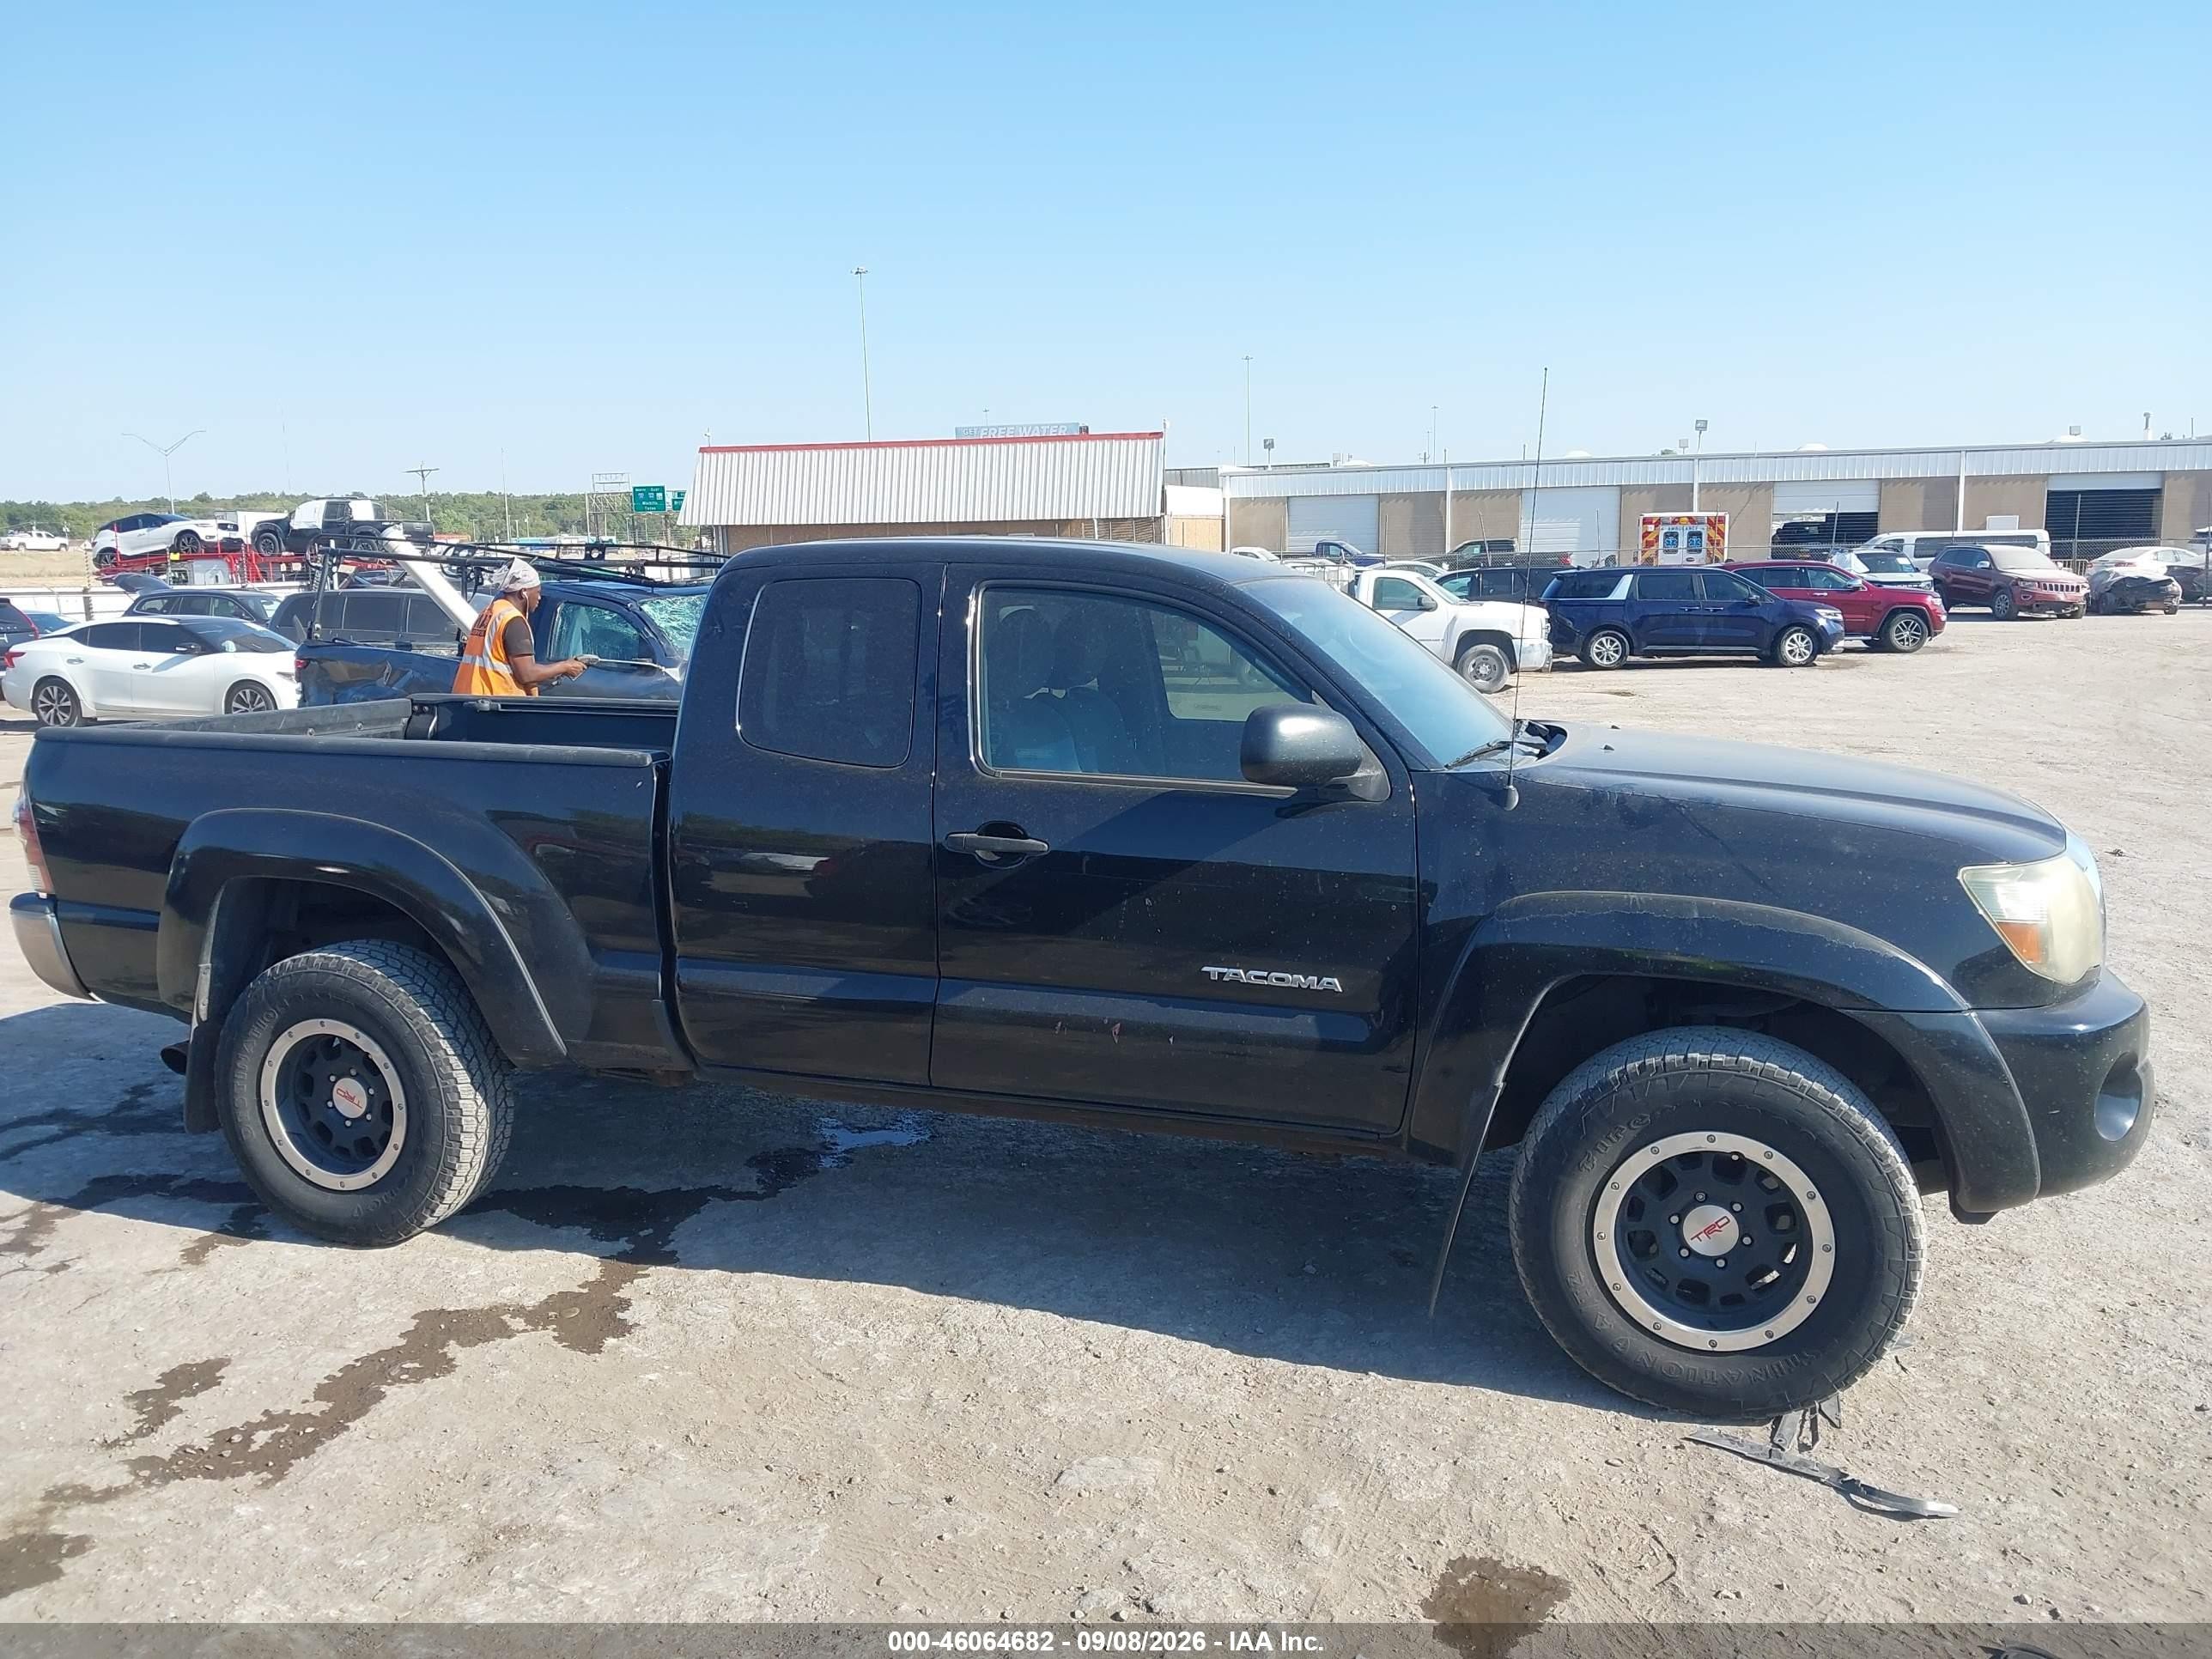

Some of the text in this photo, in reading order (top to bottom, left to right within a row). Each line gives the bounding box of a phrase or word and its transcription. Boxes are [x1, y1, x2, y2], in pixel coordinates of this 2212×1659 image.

[963, 425, 1068, 438] GET FREE WATER
[1200, 965, 1343, 993] TACOMA
[336, 1087, 363, 1109] TRD
[1690, 1215, 1731, 1243] TRD
